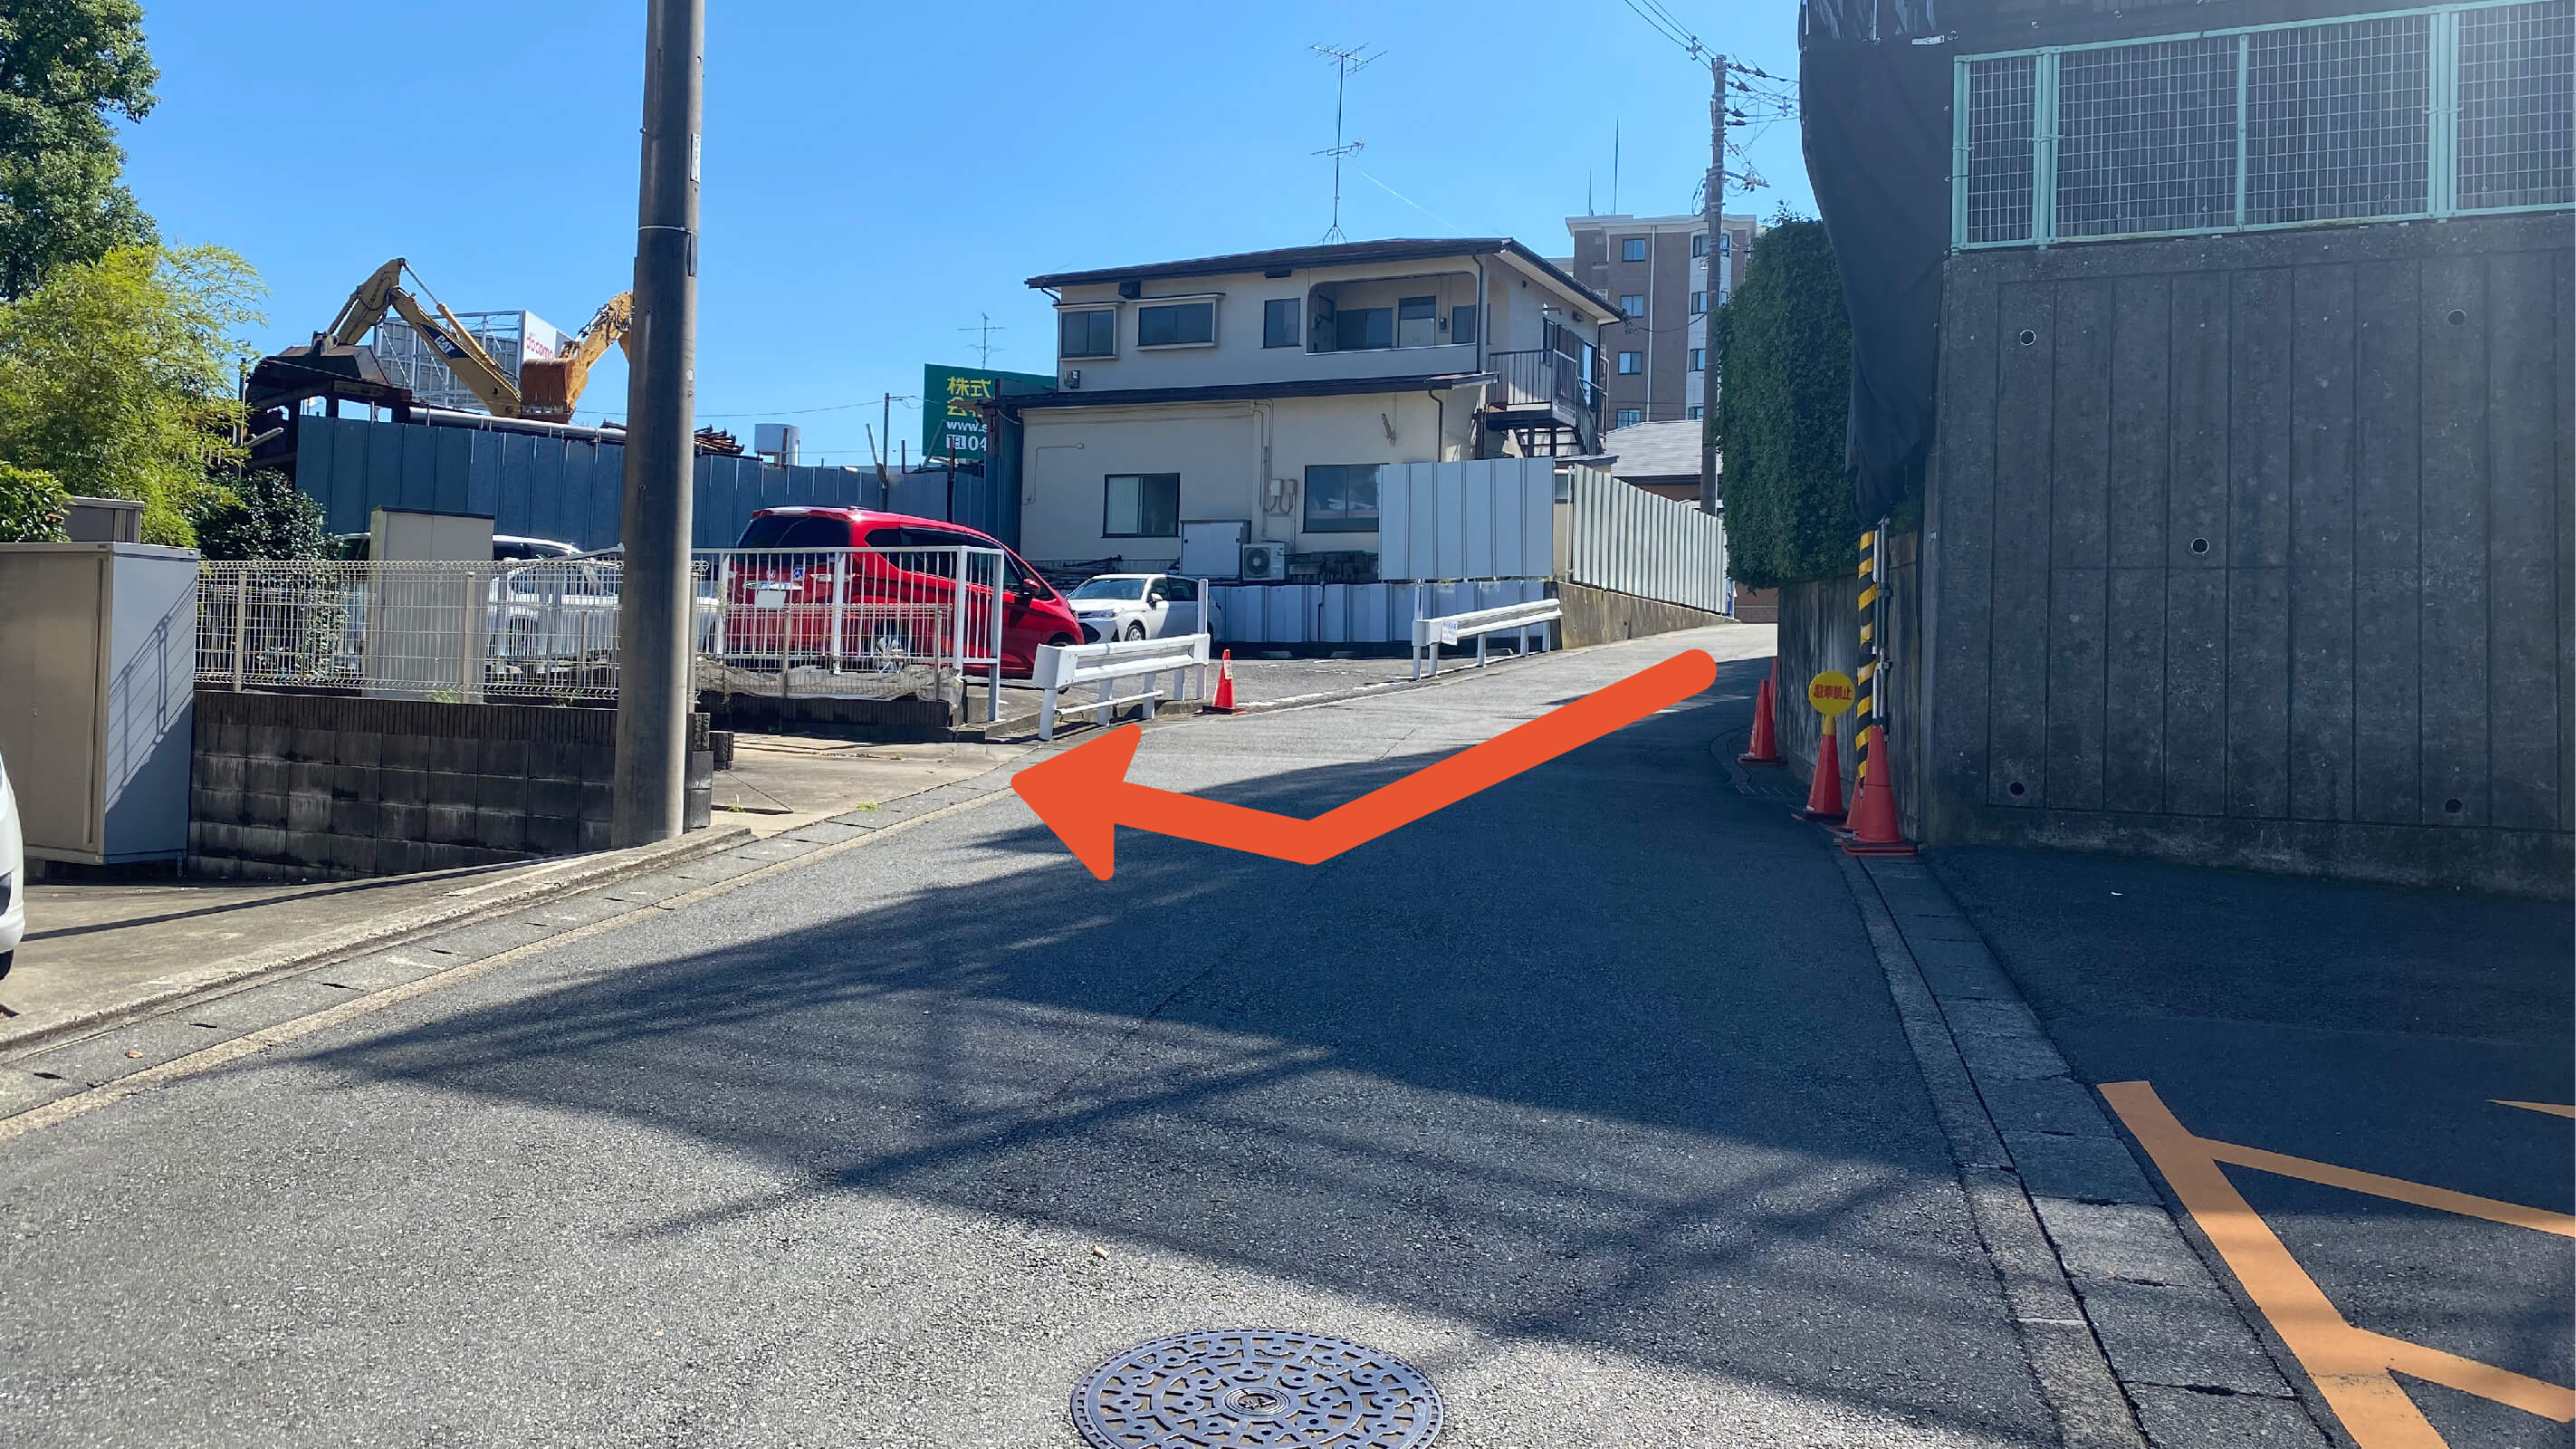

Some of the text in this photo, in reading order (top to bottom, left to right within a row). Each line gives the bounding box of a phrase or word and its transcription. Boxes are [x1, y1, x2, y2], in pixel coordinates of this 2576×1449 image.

[435, 335, 455, 354] CAT
[526, 333, 554, 360] docomo
[946, 376, 991, 398] 株式
[1814, 685, 1853, 701] 駐車禁止
